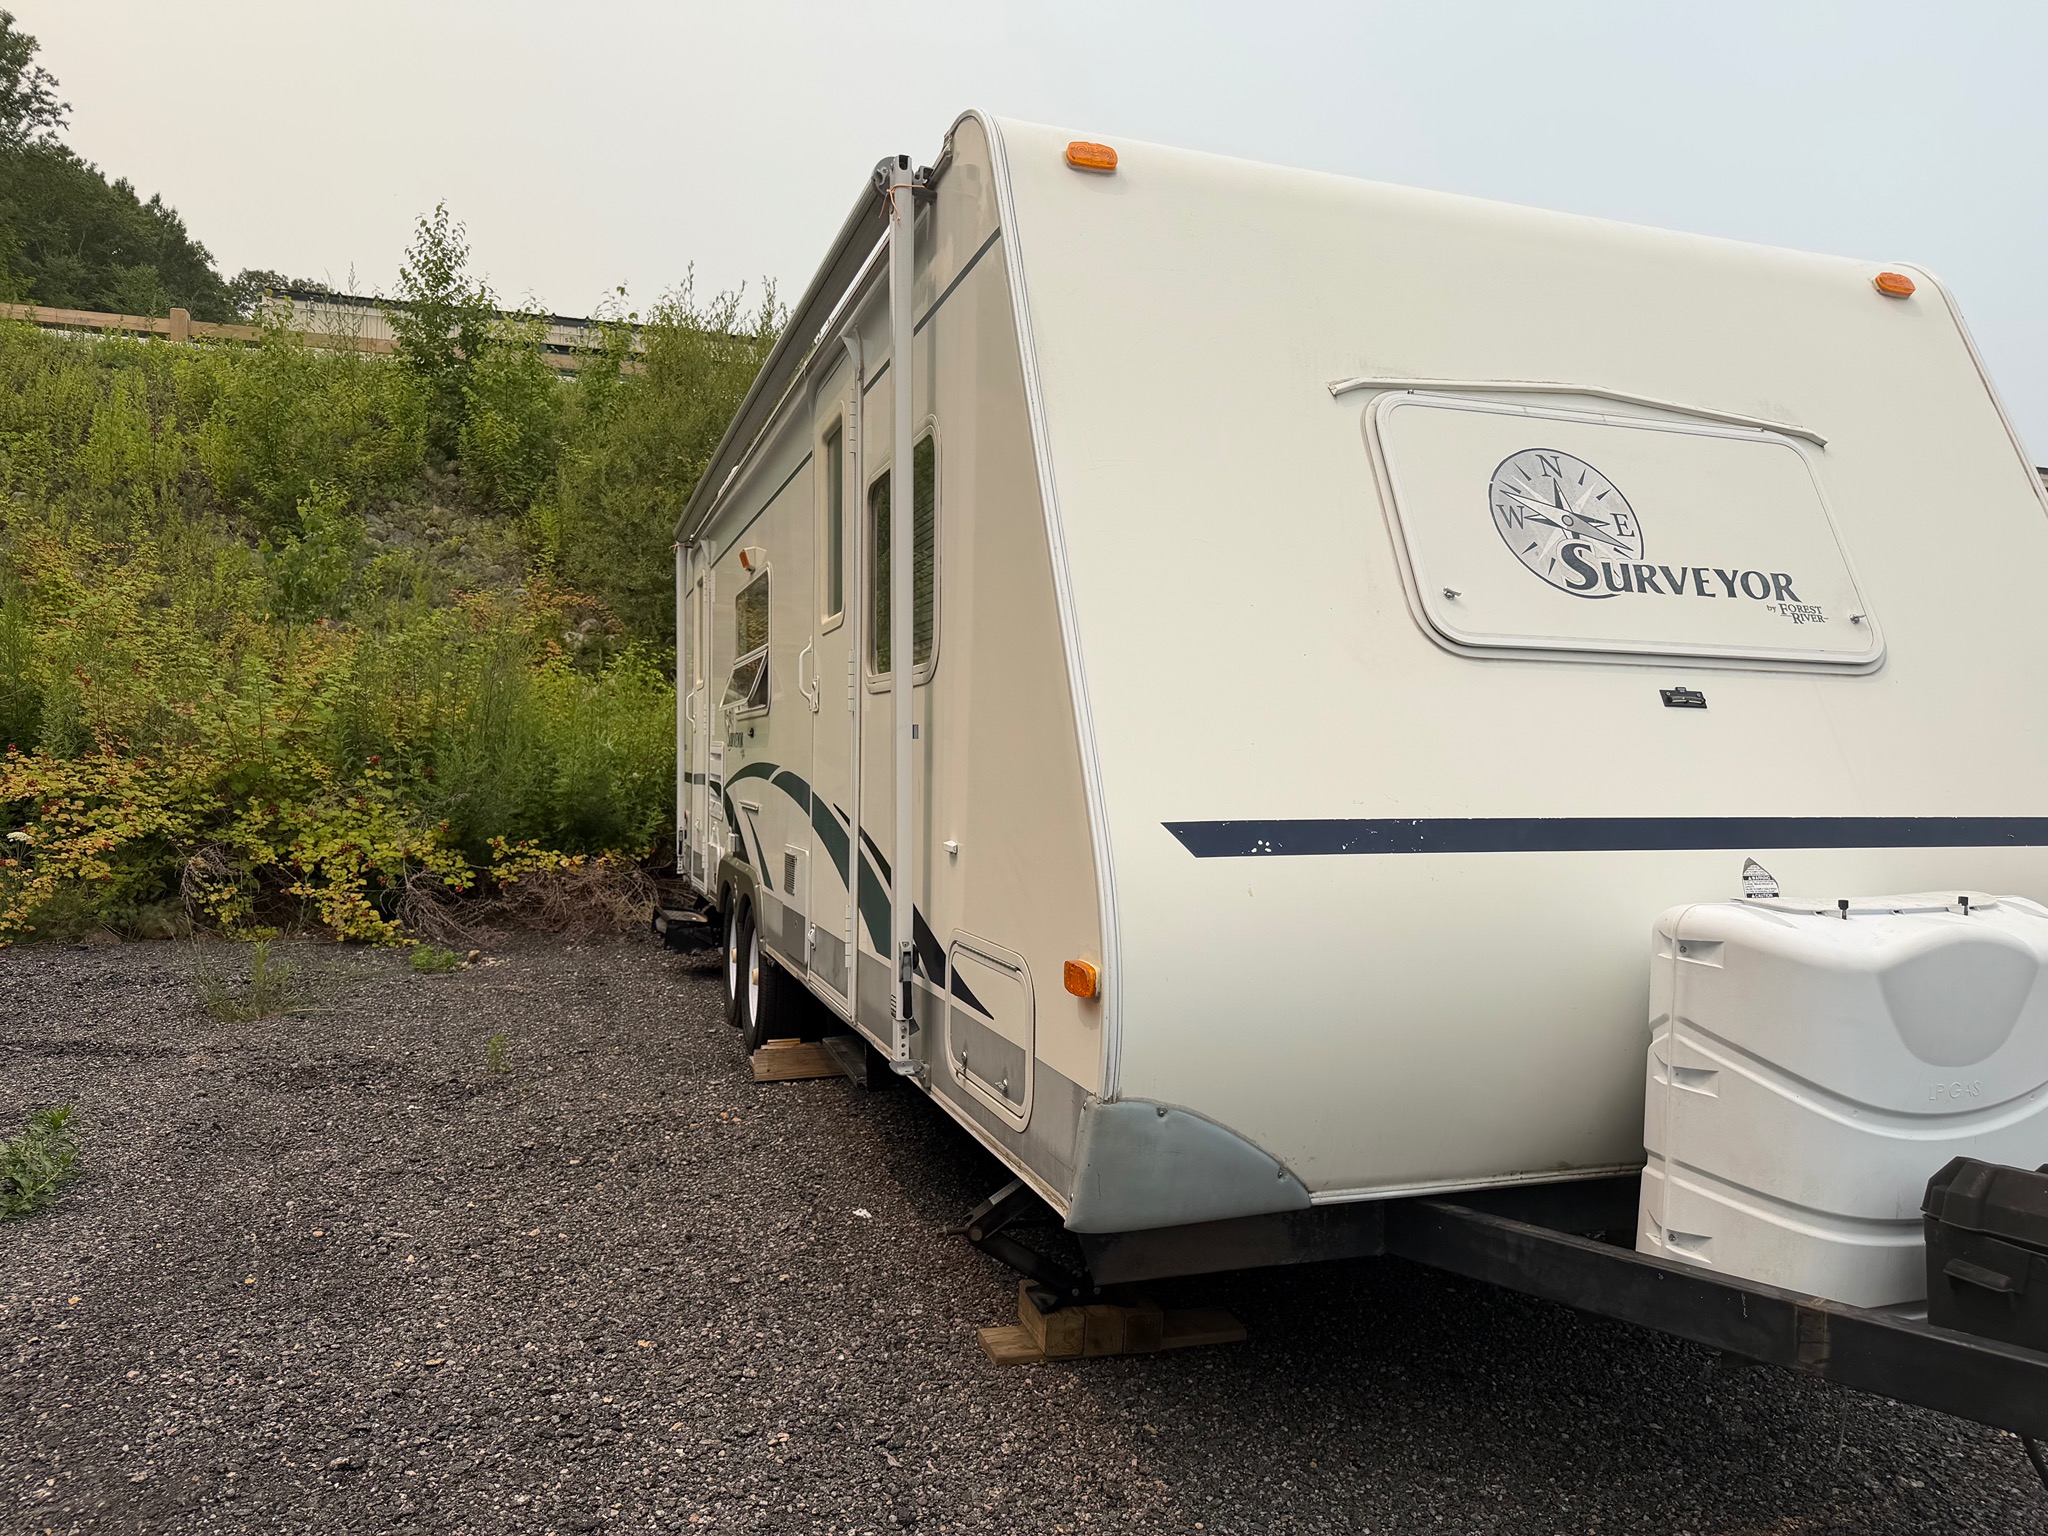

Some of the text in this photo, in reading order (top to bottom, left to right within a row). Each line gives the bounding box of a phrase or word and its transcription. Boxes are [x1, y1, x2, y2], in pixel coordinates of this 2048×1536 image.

[1535, 454, 1563, 478] N
[1496, 504, 1635, 538] W E
[1561, 543, 1802, 603] SURVEYOR
[1766, 602, 1822, 615] by FOREST
[1791, 612, 1826, 625] RIVER
[1949, 1080, 1981, 1099] GAS
